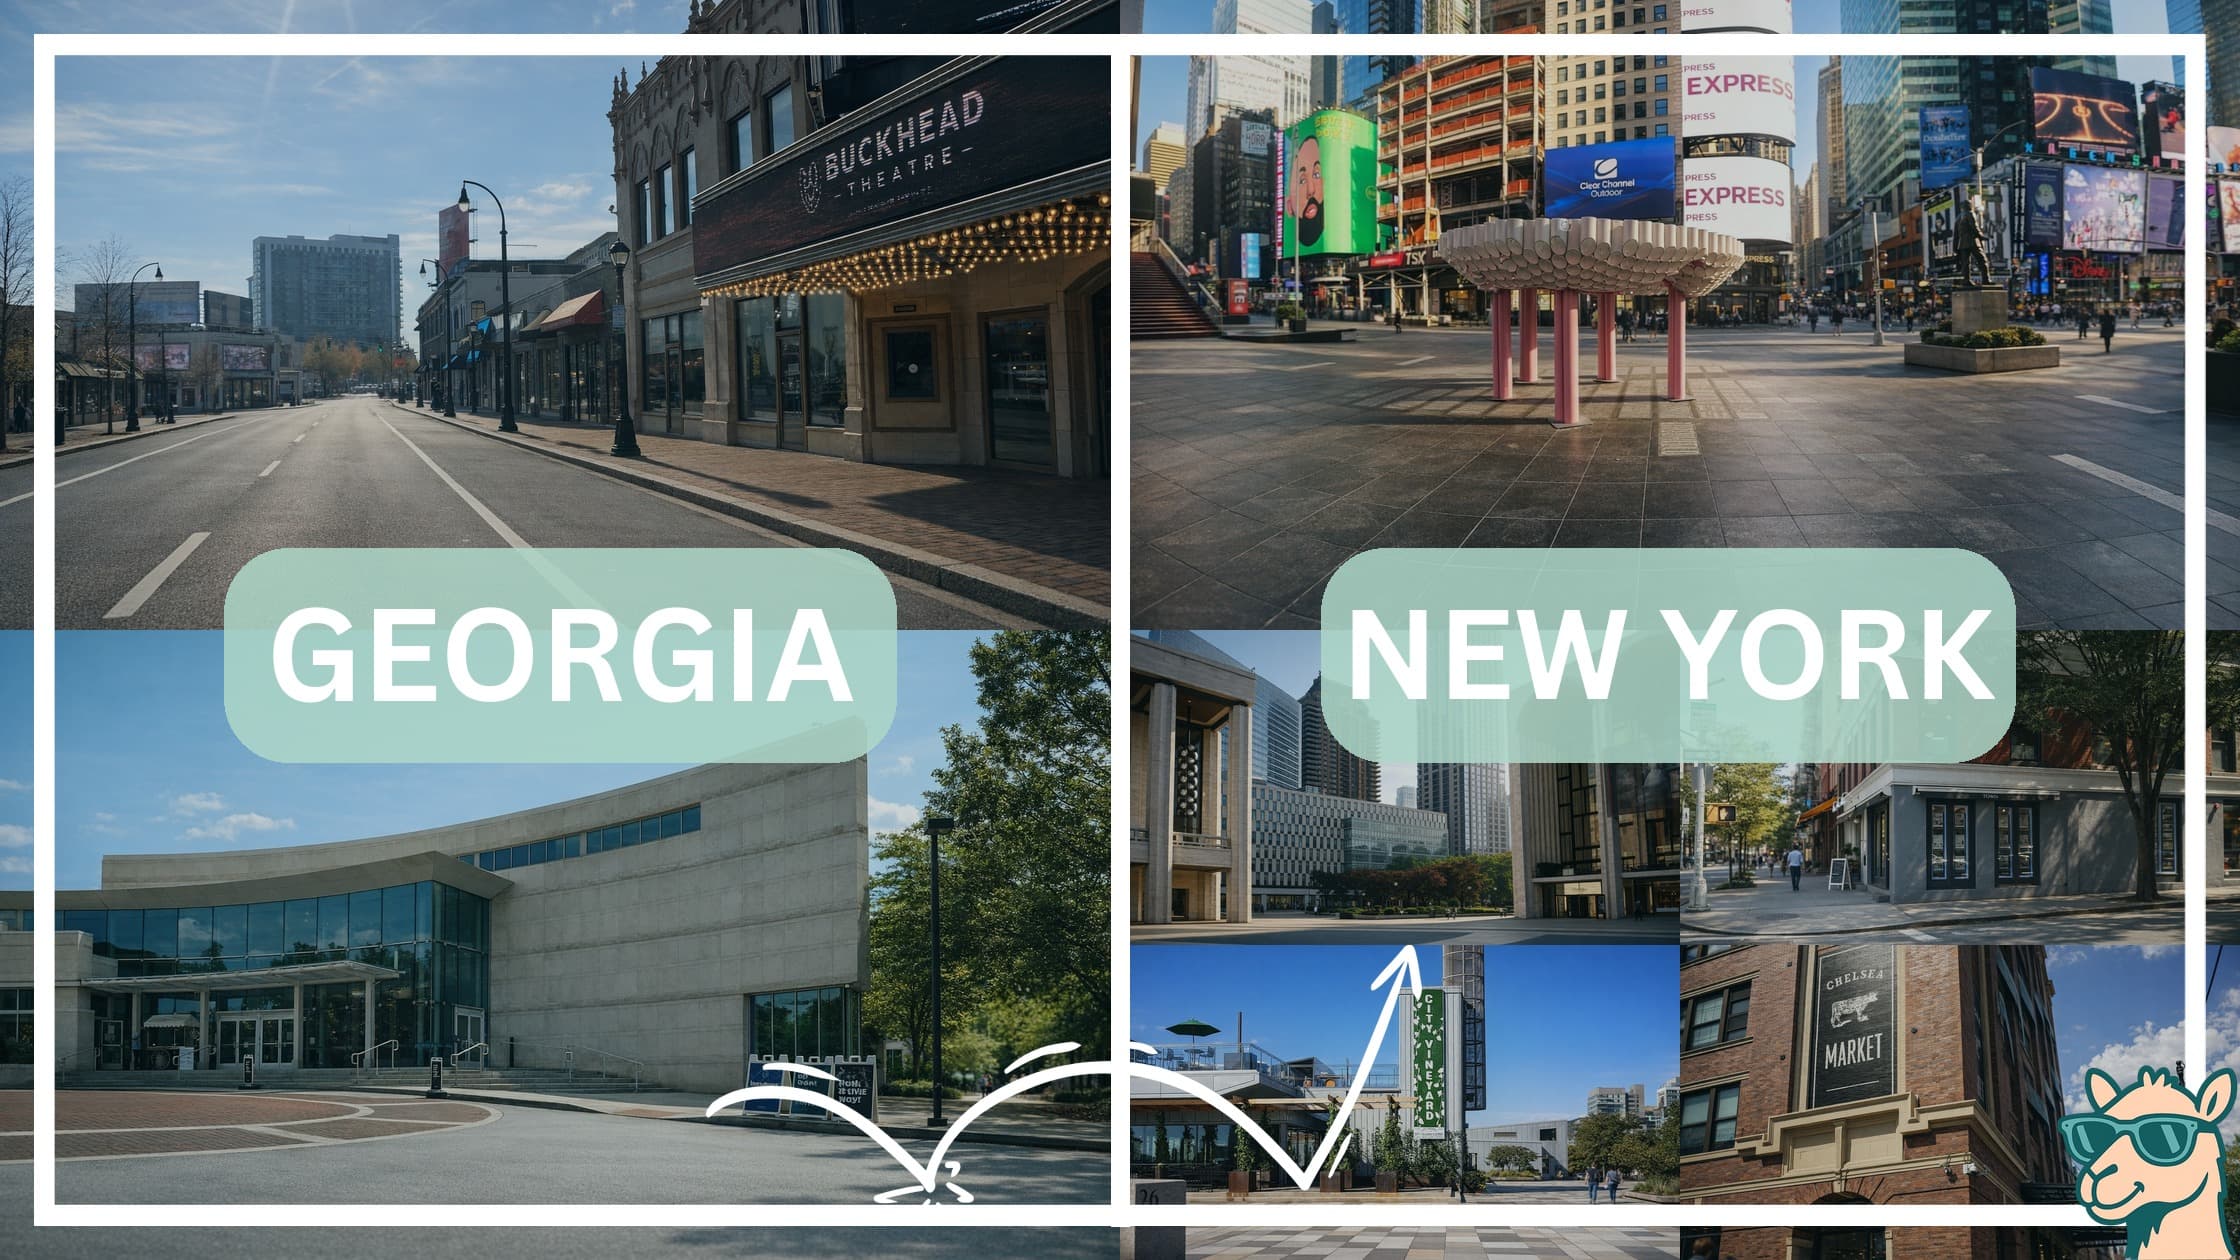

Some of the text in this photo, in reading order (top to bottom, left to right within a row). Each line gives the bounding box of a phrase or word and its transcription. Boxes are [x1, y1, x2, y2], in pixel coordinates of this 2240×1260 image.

[1680, 8, 1714, 16] PRESS
[1687, 74, 1793, 100] EXPRESS
[825, 90, 984, 181] BUCKHEAD
[847, 146, 952, 196] THEATRE
[1580, 178, 1635, 190] Clear Channel
[1590, 190, 1624, 198] Outdoor
[1685, 186, 1784, 207] EXPRESS
[1826, 969, 1884, 990] CHELSEA
[1424, 994, 1435, 1121] CITY VINEYARD
[1824, 1033, 1883, 1069] MARKET
